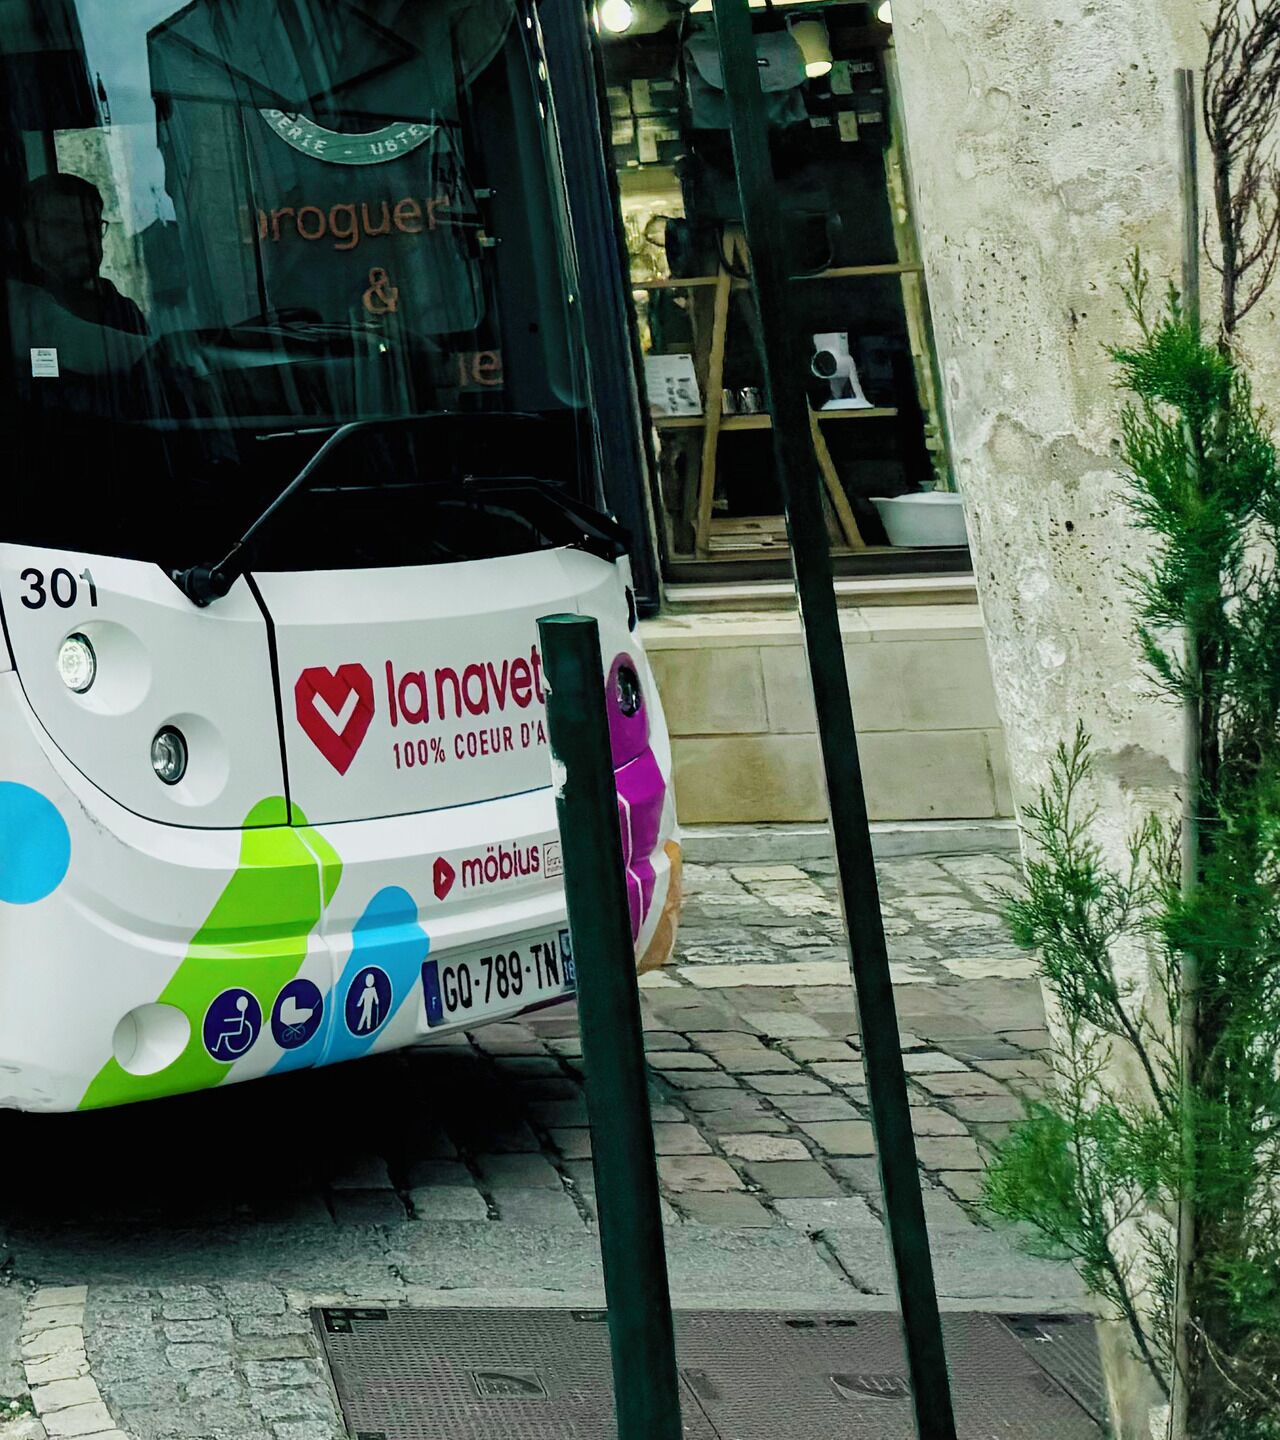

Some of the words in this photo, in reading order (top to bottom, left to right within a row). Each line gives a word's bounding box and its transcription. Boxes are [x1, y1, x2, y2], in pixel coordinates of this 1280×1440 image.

[20, 568, 97, 608] 301
[385, 660, 430, 727] la
[434, 644, 545, 720] navet
[393, 736, 446, 769] 100%
[454, 725, 514, 760] COEUR
[520, 719, 547, 748] D'A
[461, 842, 540, 888] möbius
